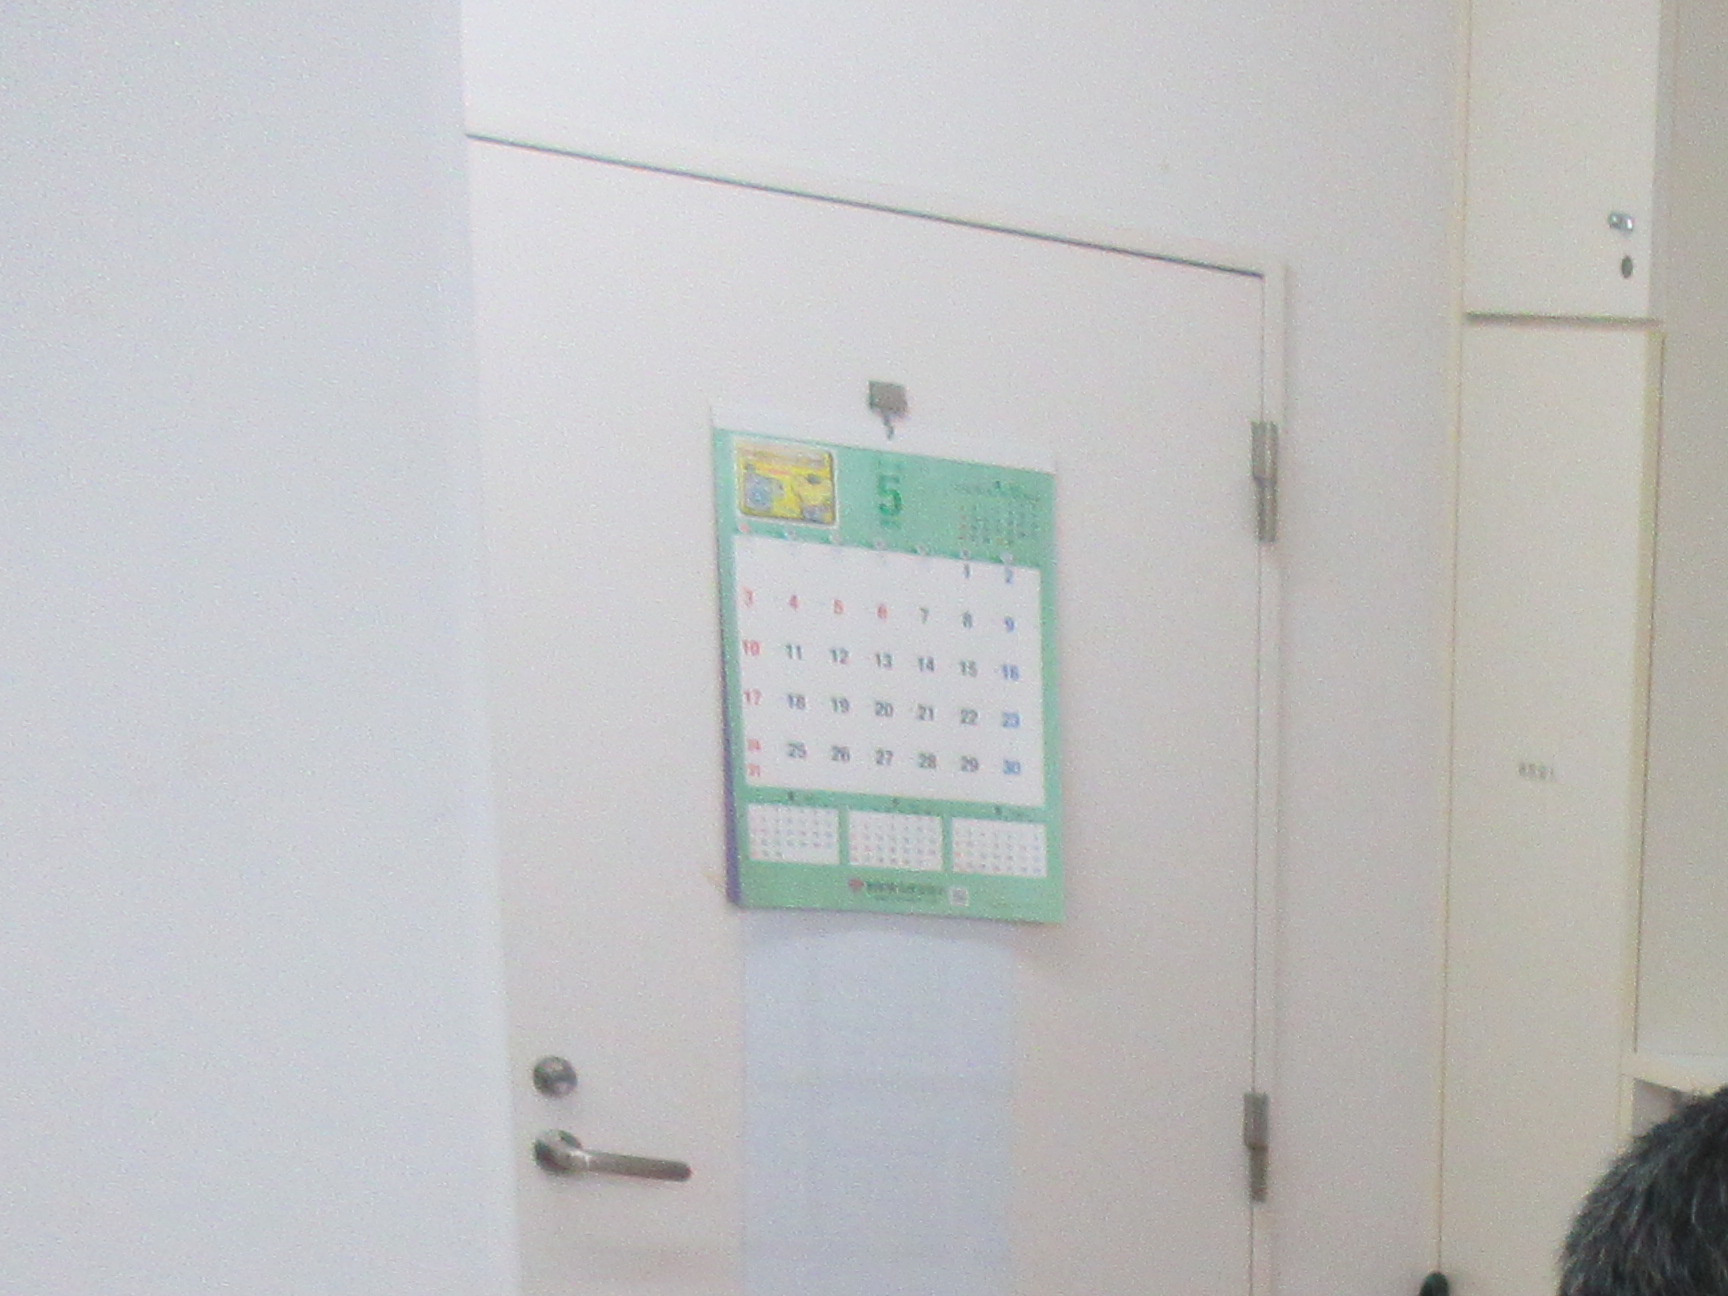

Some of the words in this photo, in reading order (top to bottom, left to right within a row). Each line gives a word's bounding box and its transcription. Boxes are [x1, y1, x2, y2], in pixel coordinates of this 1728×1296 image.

[878, 474, 903, 518] 5
[918, 606, 929, 624] 7
[742, 639, 761, 656] 10
[785, 643, 803, 661] 11
[830, 647, 849, 665] 12
[875, 651, 893, 669] 13
[917, 656, 935, 673] 14
[959, 660, 978, 678] 15
[786, 693, 806, 710] 18
[831, 697, 850, 714] 19
[875, 700, 894, 718] 20
[917, 704, 935, 722] 21
[960, 708, 979, 726] 22
[786, 741, 807, 759] 25
[831, 745, 850, 762] 26
[875, 749, 894, 766] 27
[918, 753, 937, 770] 28
[960, 756, 979, 773] 29
